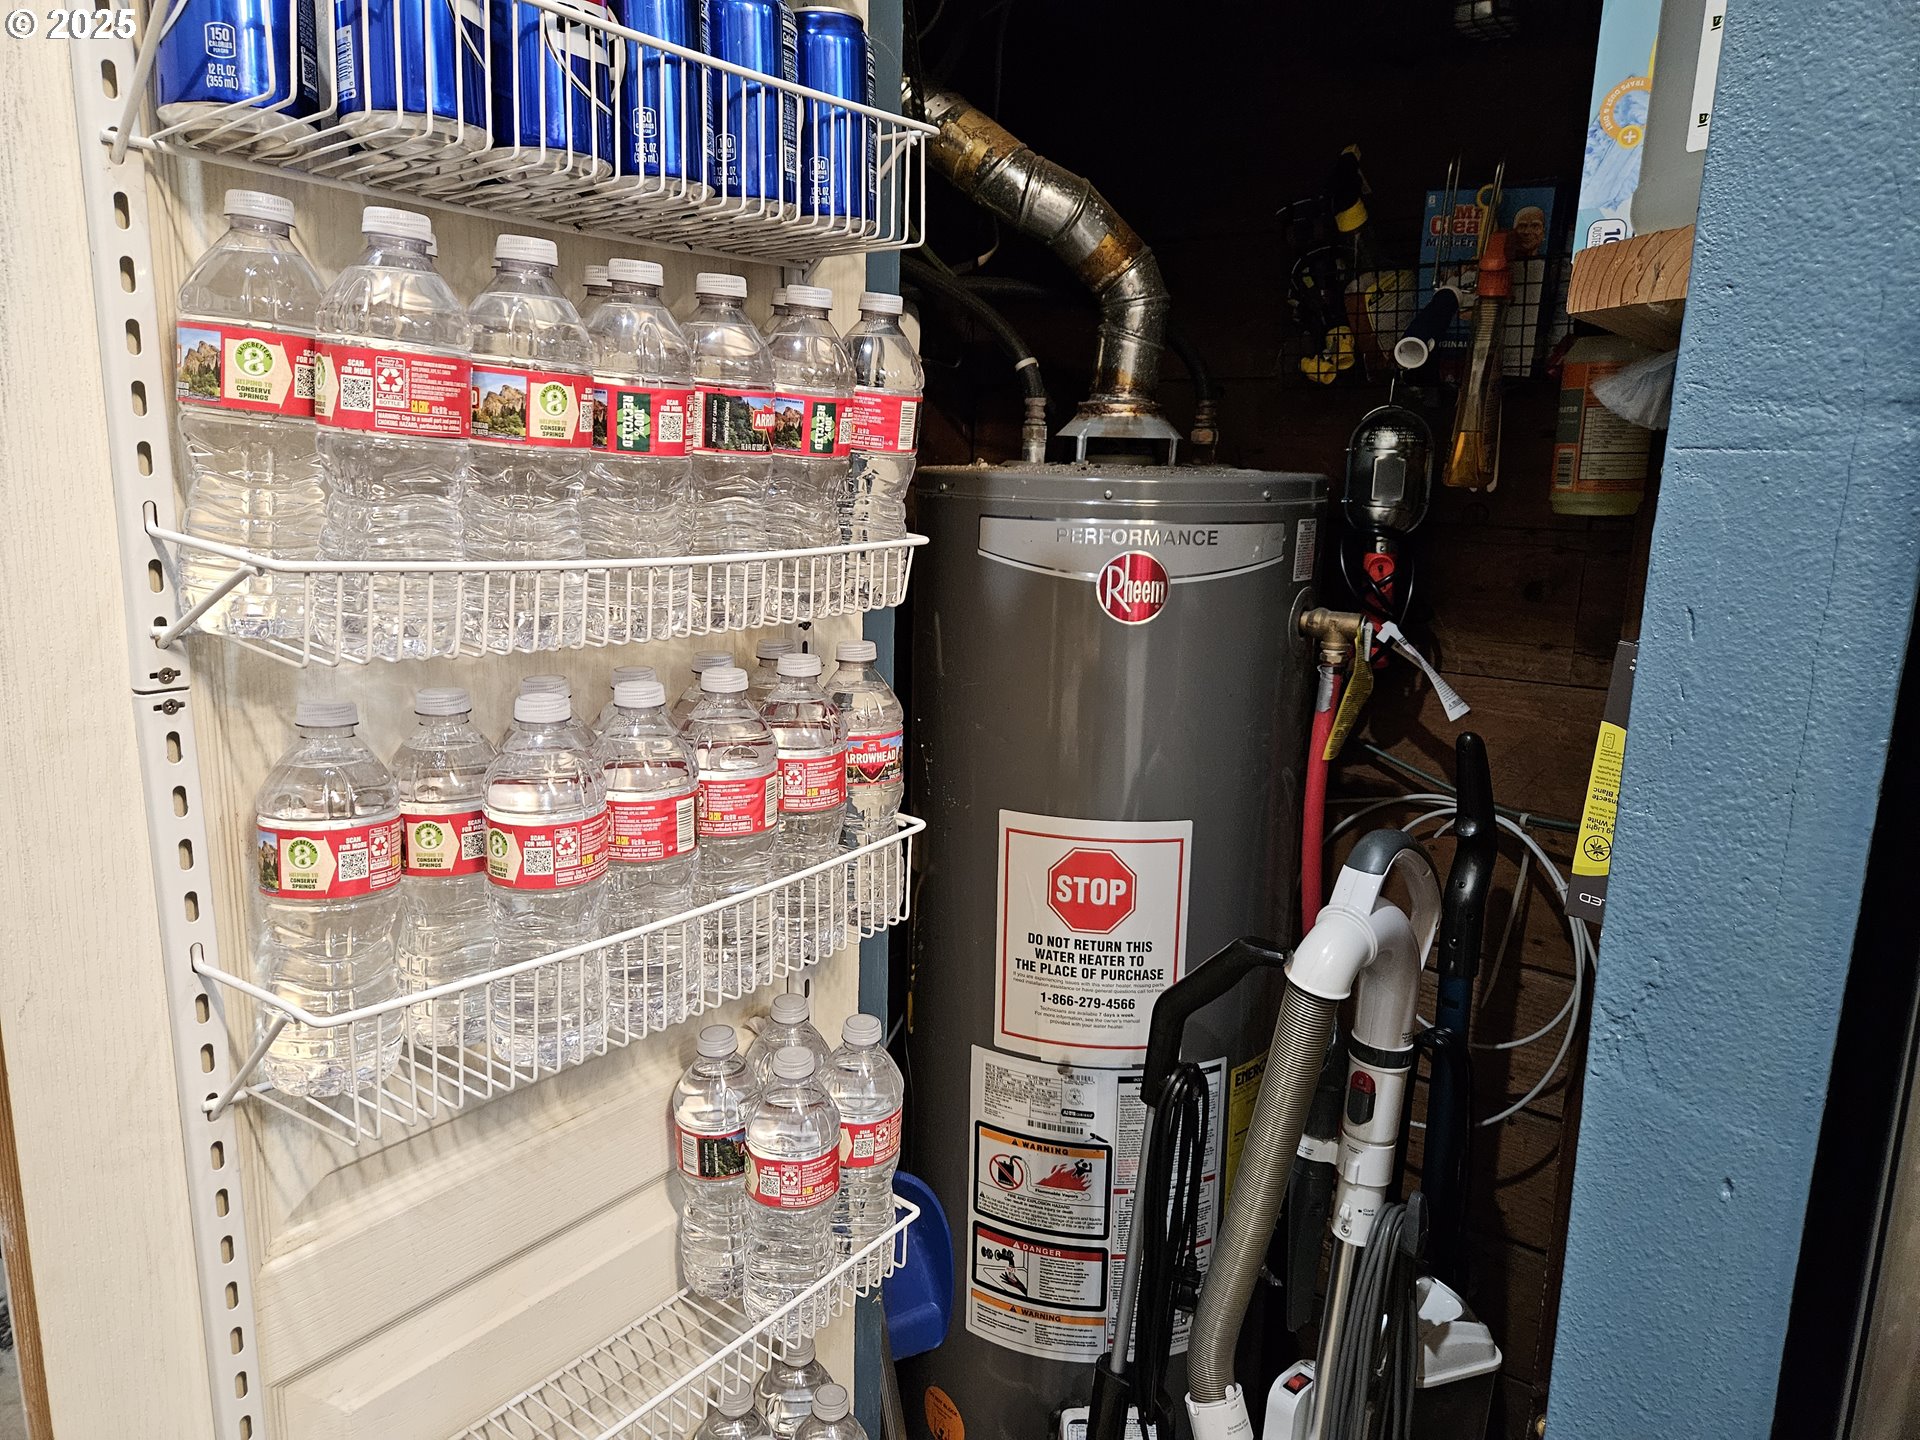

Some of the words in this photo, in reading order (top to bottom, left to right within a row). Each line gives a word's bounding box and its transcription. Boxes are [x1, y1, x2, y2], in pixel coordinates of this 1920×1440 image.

[210, 27, 229, 42] 150
[208, 40, 233, 49] CALORIES
[208, 63, 216, 75] 12
[217, 64, 225, 76] FL
[226, 65, 236, 77] OZ
[206, 75, 223, 88] (355
[224, 78, 239, 91] mL)
[1621, 80, 1644, 91] TRAPS
[347, 358, 365, 367] SCAN
[341, 365, 353, 374] FOR
[353, 367, 372, 376] MORE
[236, 385, 271, 395] CONSERVE
[238, 392, 269, 401] SPRINGS
[378, 393, 402, 401] PLASTIC
[622, 394, 634, 449] RECYCLED
[634, 408, 645, 437] 100%
[540, 424, 566, 432] CONSERVE
[814, 404, 826, 451] RECYCLED
[824, 415, 833, 442] 100%
[542, 430, 565, 438] SPRINGS
[1056, 527, 1219, 546] PERFORMANCE
[1105, 553, 1165, 613] Rheem
[845, 749, 896, 764] ARROWHEAD
[1592, 787, 1614, 798] Blanc
[1587, 816, 1608, 827] White
[1586, 823, 1604, 834] Light
[345, 836, 362, 844] SCAN
[352, 841, 368, 850] MORE
[289, 877, 318, 885] CONSERVE
[1055, 874, 1127, 906] STOP
[1028, 932, 1043, 945] DO
[1047, 935, 1070, 949] NOT
[1074, 938, 1122, 953] RETURN
[1126, 941, 1153, 953] THIS
[1034, 947, 1075, 964] WATER
[1079, 953, 1125, 967] HEATER
[1129, 955, 1144, 967] TO
[1015, 957, 1036, 972] THE
[1040, 962, 1077, 978] PLACE
[1081, 967, 1097, 980] OF
[1101, 968, 1164, 981] PURCHASE
[1034, 974, 1064, 985] experiencing
[1025, 978, 1049, 987] installation
[1050, 982, 1075, 991] assistance
[1094, 987, 1113, 995] general
[1040, 991, 1135, 1010] 1-866-279-4566
[1040, 1005, 1067, 1014] Technicians
[1049, 1018, 1070, 1027] provided
[1056, 1014, 1084, 1022] information,
[1021, 1140, 1069, 1156] WARNING
[1035, 1188, 1061, 1197] Flammable
[1026, 1196, 1051, 1206] EXPLOSION
[1022, 1244, 1062, 1257] DANGER
[1021, 1308, 1061, 1322] WARNING
